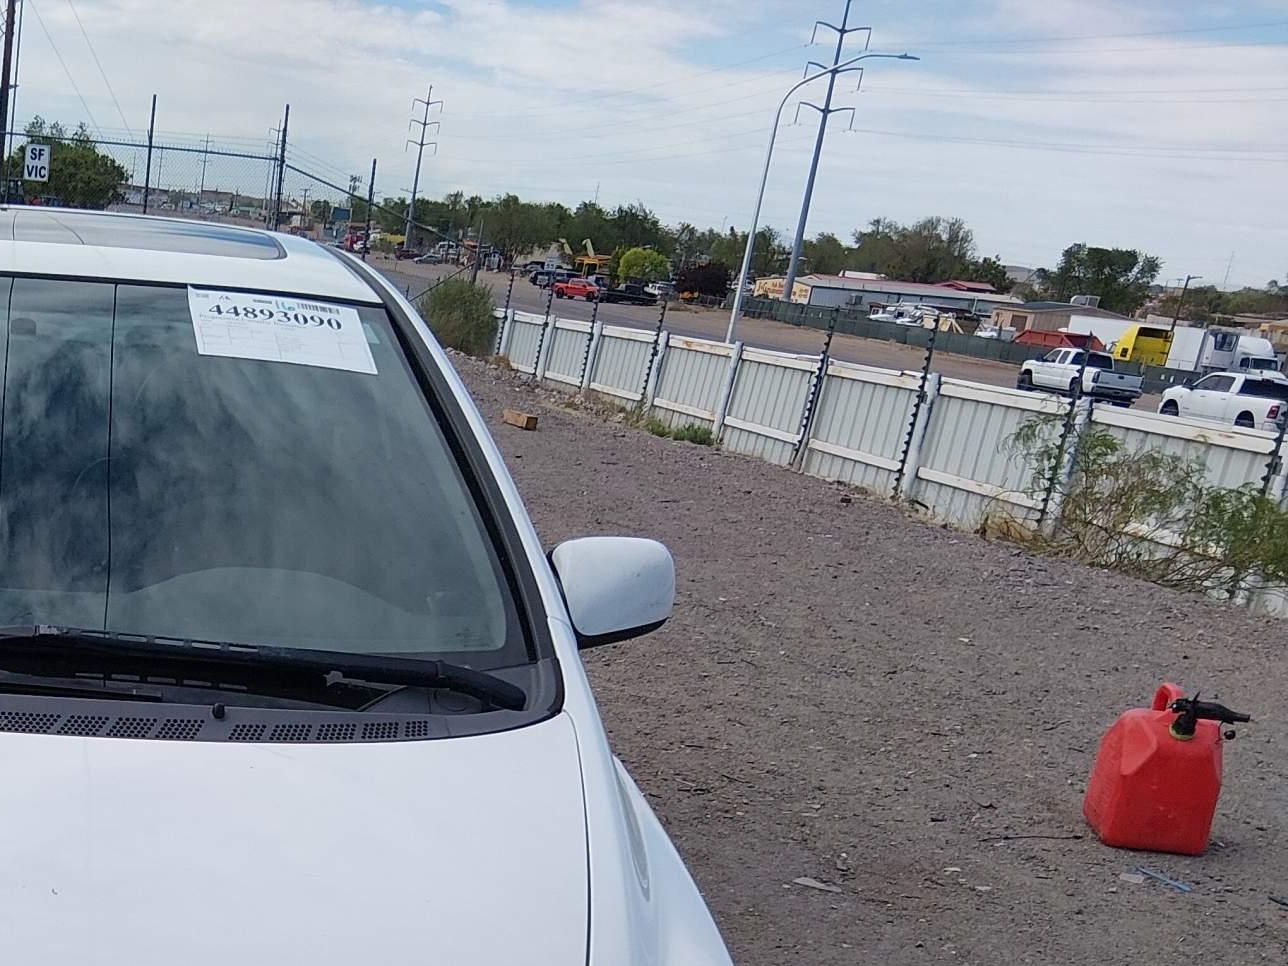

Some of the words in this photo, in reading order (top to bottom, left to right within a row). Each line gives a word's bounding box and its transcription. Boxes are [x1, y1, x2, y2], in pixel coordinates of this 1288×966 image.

[30, 147, 45, 162] SF
[26, 164, 47, 179] VIC
[208, 303, 343, 332] 44893090
